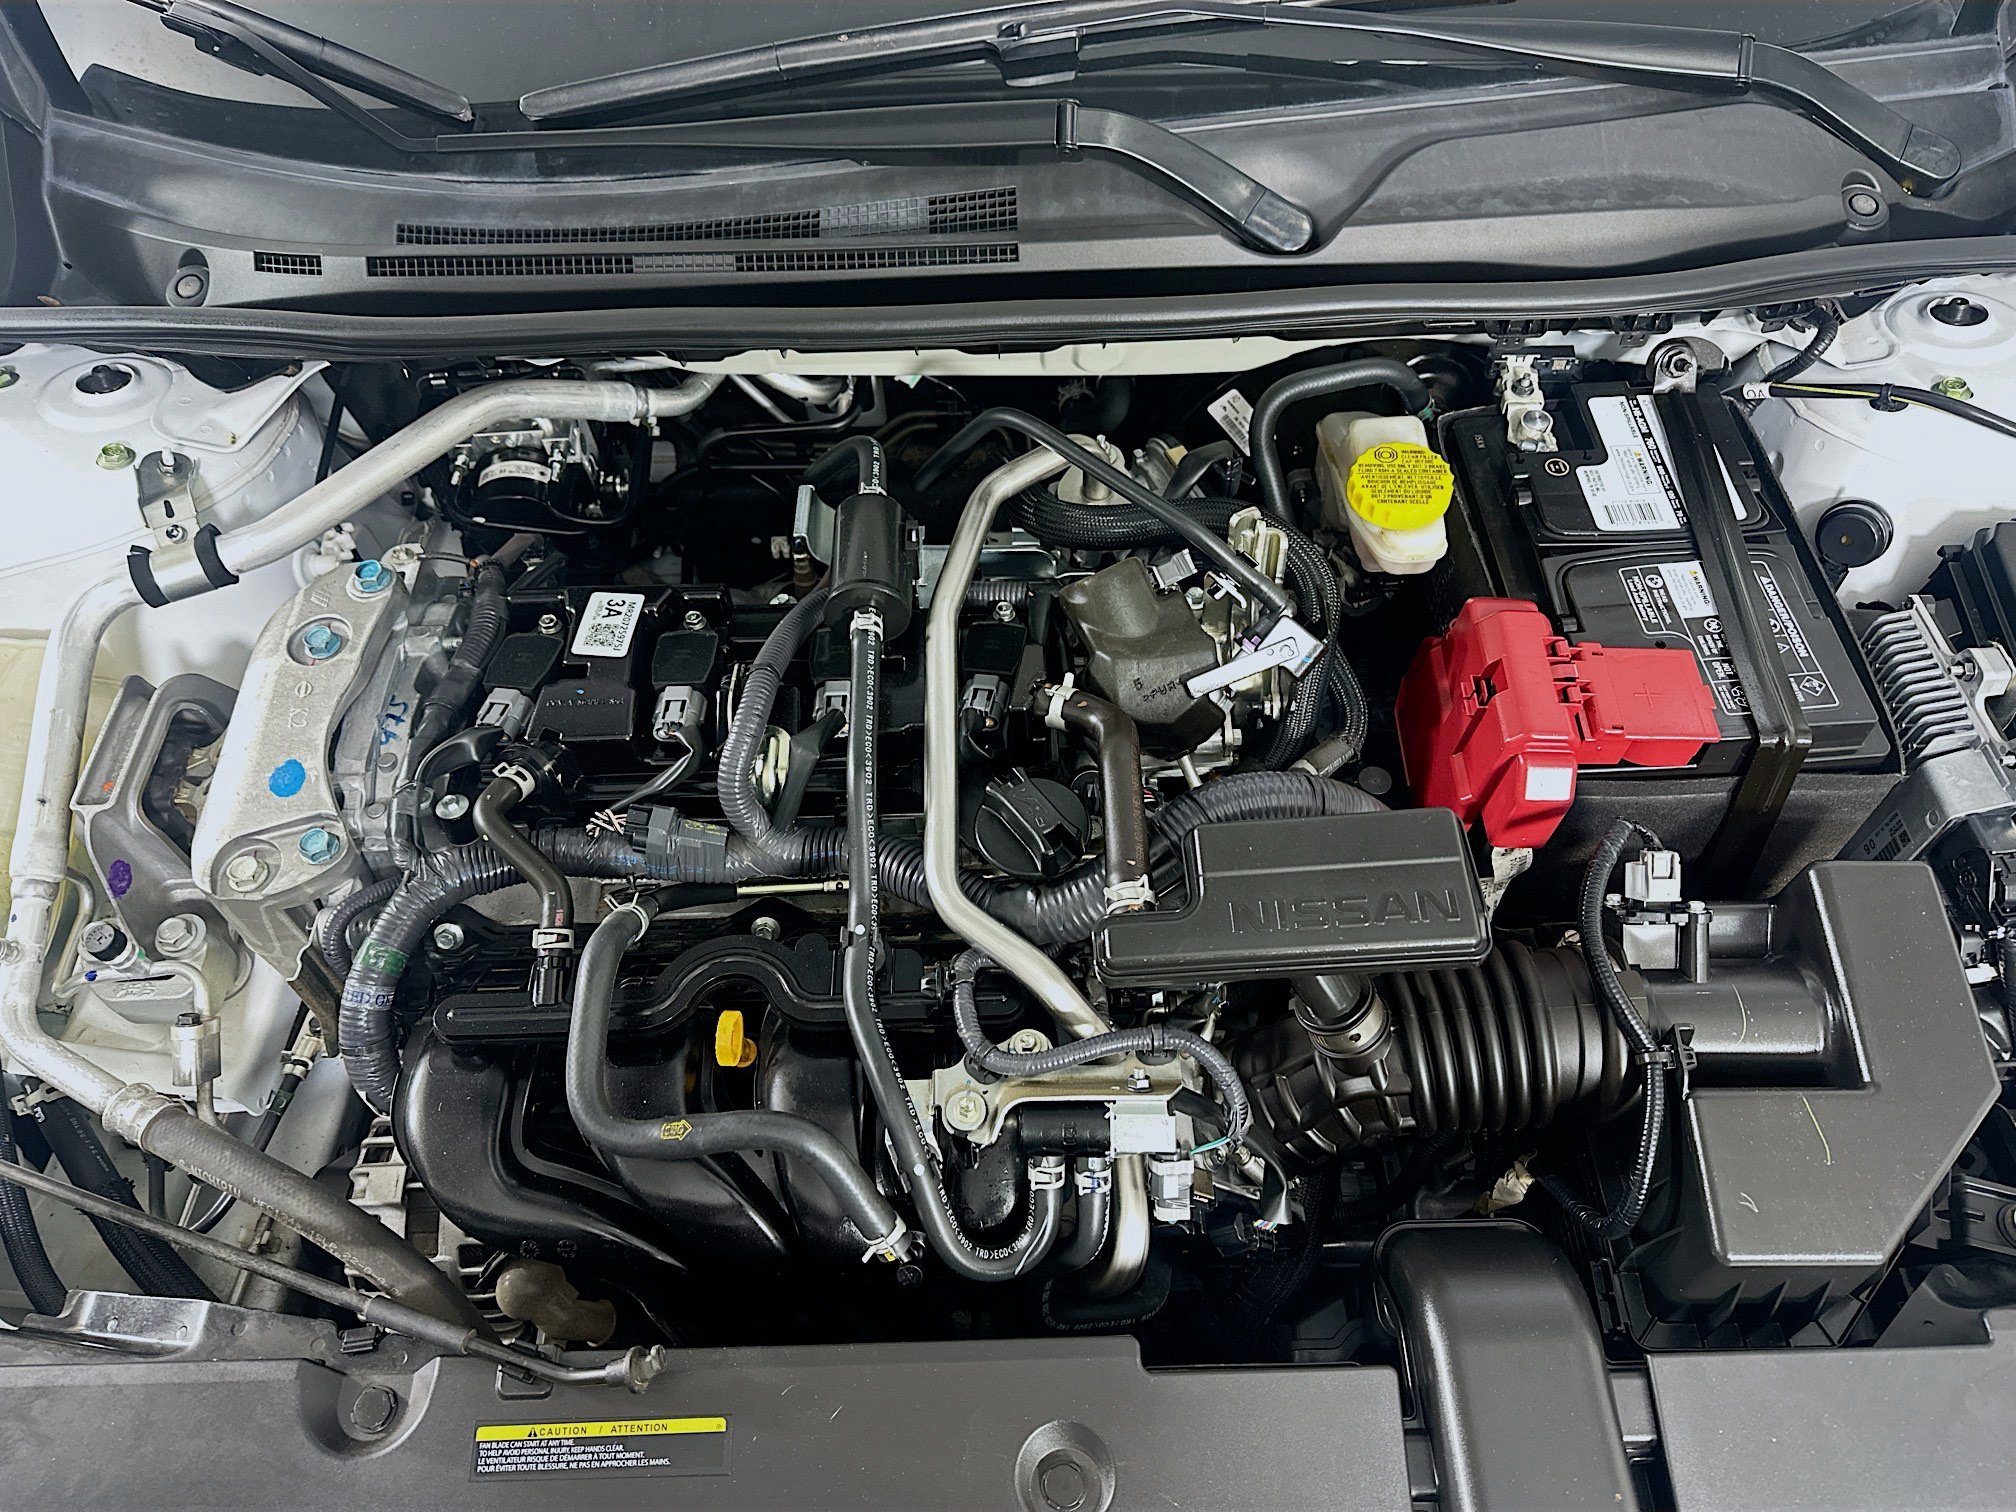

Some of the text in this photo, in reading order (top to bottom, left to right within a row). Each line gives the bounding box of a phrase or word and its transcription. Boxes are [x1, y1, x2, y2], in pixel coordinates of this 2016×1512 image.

[602, 599, 626, 618] 3A
[1632, 575, 1659, 624] NON-SPILLABLE
[1764, 584, 1809, 658] DANGER/POISON
[866, 649, 876, 710] TRD>ECO<3902
[1722, 662, 1734, 675] NOT
[864, 714, 875, 785] TRD>ECO<3902
[865, 792, 877, 869] TRD>ECO<3902
[1229, 889, 1461, 933] NISSAN
[866, 945, 878, 1013] TRD>ECO<3902
[875, 1018, 906, 1090] TRD>ECO<3902
[937, 1183, 973, 1252] TRD>ECO<3902
[487, 1449, 503, 1457] HELP
[520, 1448, 549, 1456] PERSONAL
[491, 1441, 510, 1449] BLADE
[523, 1440, 540, 1448] START
[540, 1426, 587, 1436] CAUTION
[610, 1423, 668, 1433] ATTENTION
[477, 1465, 496, 1473] POUR
[496, 1463, 517, 1472] ÉVITER
[537, 1462, 568, 1470] BLESSURE,
[569, 1461, 579, 1469] NE
[600, 1459, 637, 1467] APPROCHER
[637, 1458, 648, 1466] LES
[649, 1457, 671, 1466] MAINS.
[486, 1456, 526, 1464] VENTILATEUR
[526, 1455, 549, 1463] RISQUE
[559, 1452, 592, 1461] DÉMARRER
[598, 1452, 615, 1460] TOUT
[615, 1451, 645, 1459] MOMENT.
